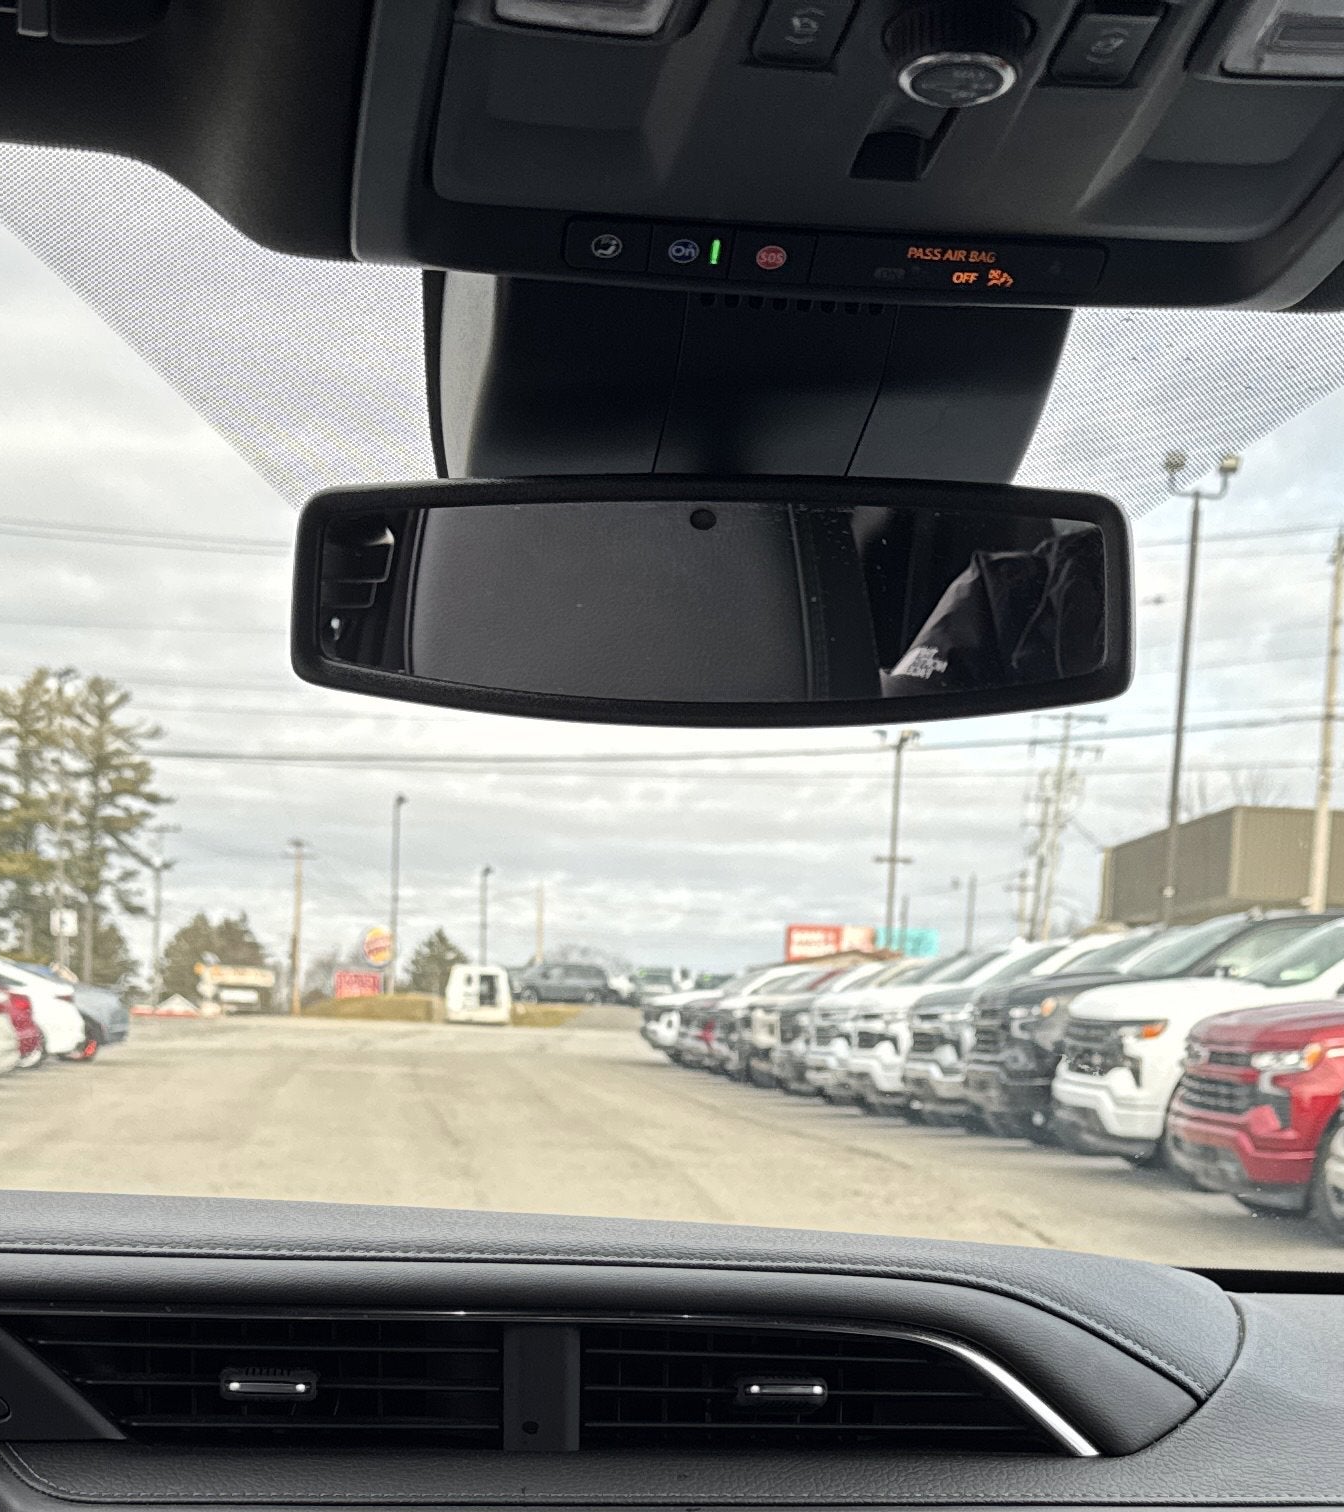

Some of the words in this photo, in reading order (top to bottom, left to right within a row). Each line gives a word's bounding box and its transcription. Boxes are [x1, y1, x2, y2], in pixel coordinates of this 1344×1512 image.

[760, 250, 783, 265] SOS
[907, 246, 942, 261] PASS
[942, 249, 967, 262] AIR
[968, 250, 996, 264] BAG
[952, 271, 979, 284] OFF
